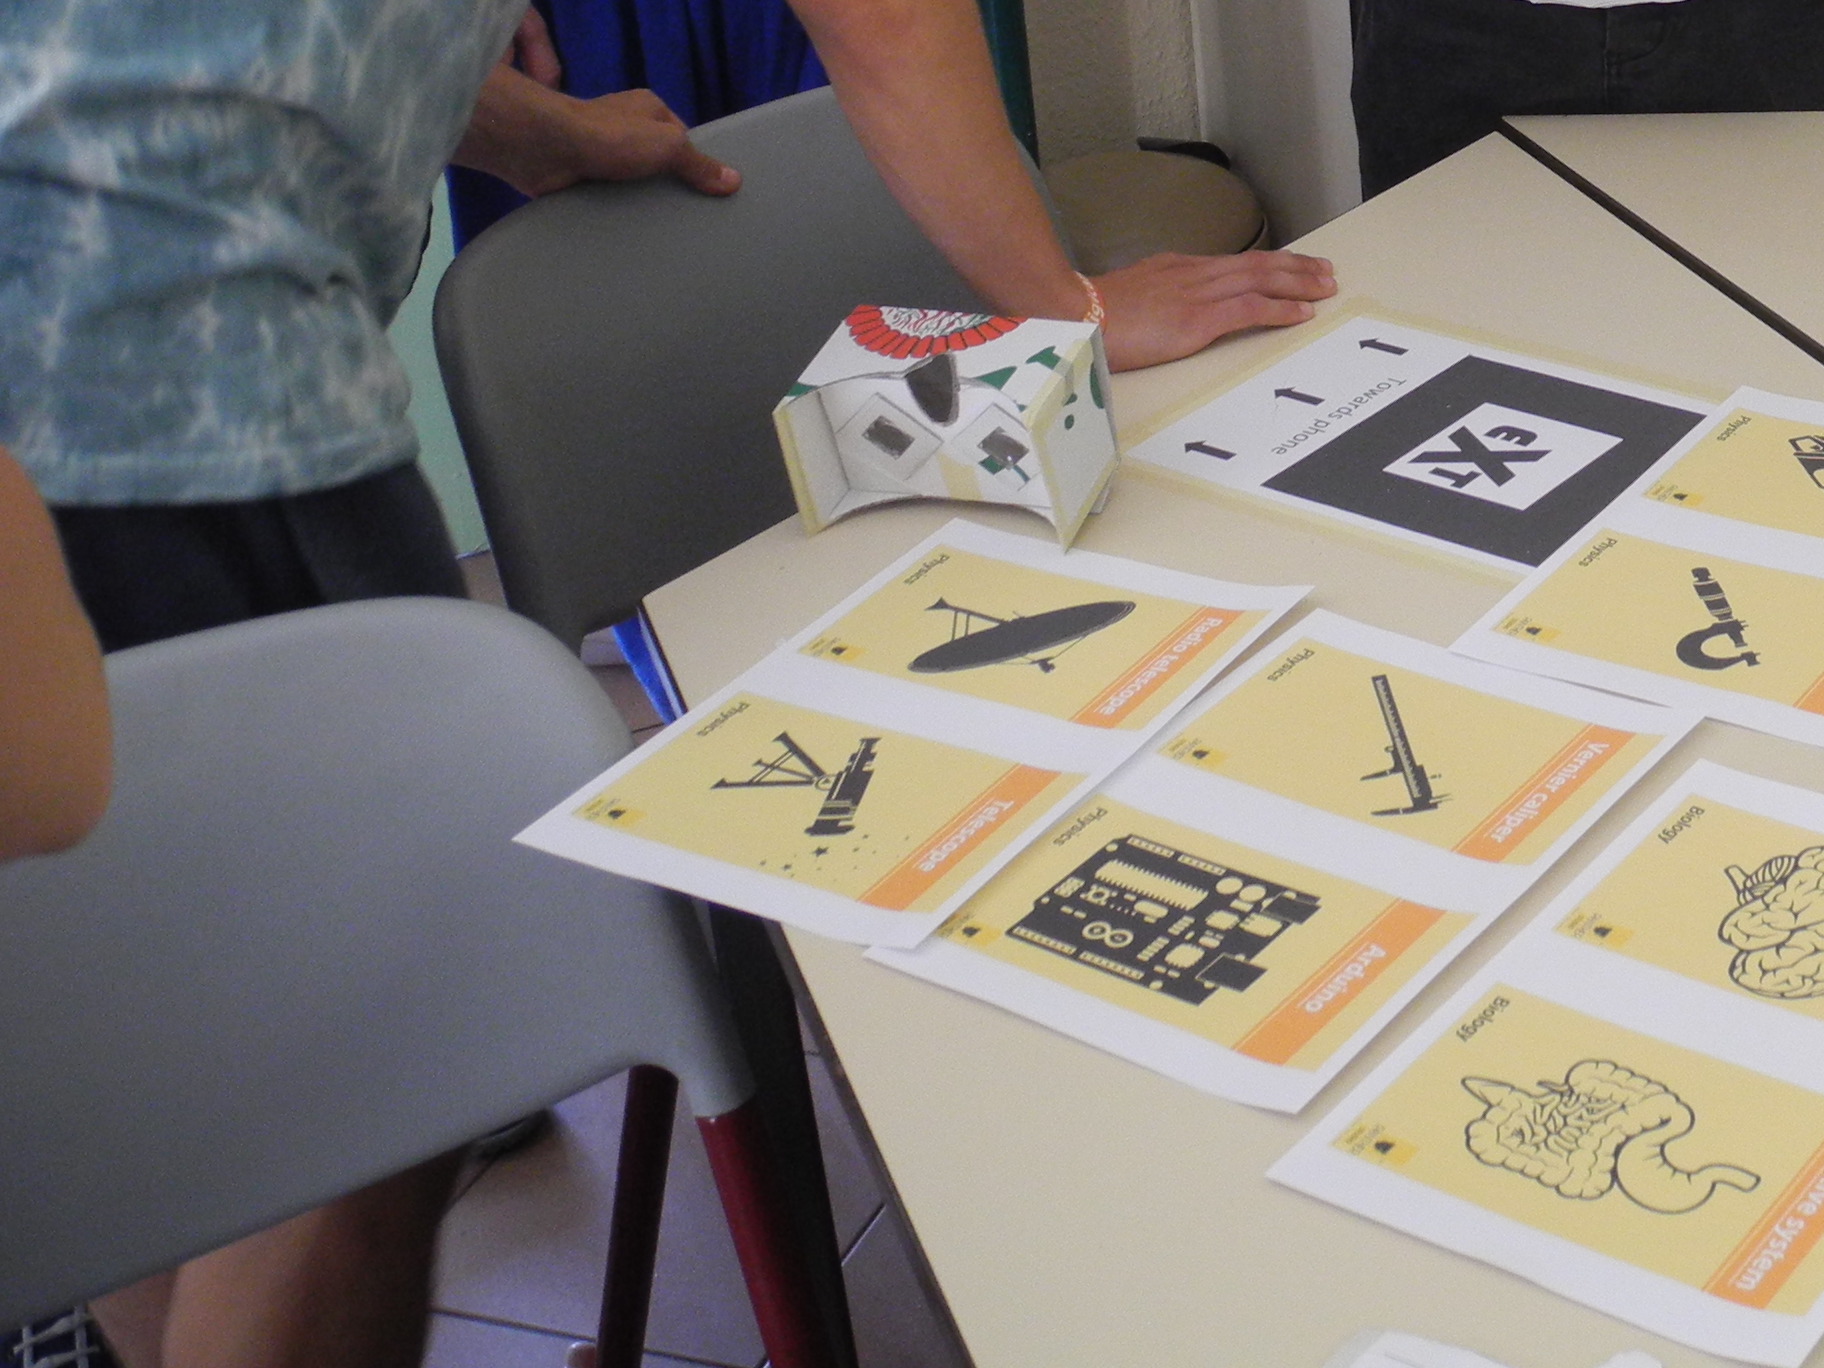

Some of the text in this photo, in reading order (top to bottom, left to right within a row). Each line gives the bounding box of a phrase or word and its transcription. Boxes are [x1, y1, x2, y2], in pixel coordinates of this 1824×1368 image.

[1272, 375, 1407, 456] Towards phone
[1717, 415, 1752, 442] Physics
[903, 553, 949, 585] Physics
[1578, 537, 1617, 567] Physics
[1100, 617, 1223, 716] Radio telescope
[1267, 647, 1315, 681] Physics
[697, 701, 749, 737] Physics
[1490, 741, 1610, 844] Vernier caliper
[920, 799, 1013, 873] Telescope
[1053, 807, 1107, 847] Physics
[1658, 805, 1705, 844] Biology
[1304, 944, 1386, 1013] Arduino
[1455, 995, 1510, 1042] Biology
[1734, 1216, 1805, 1291] system
